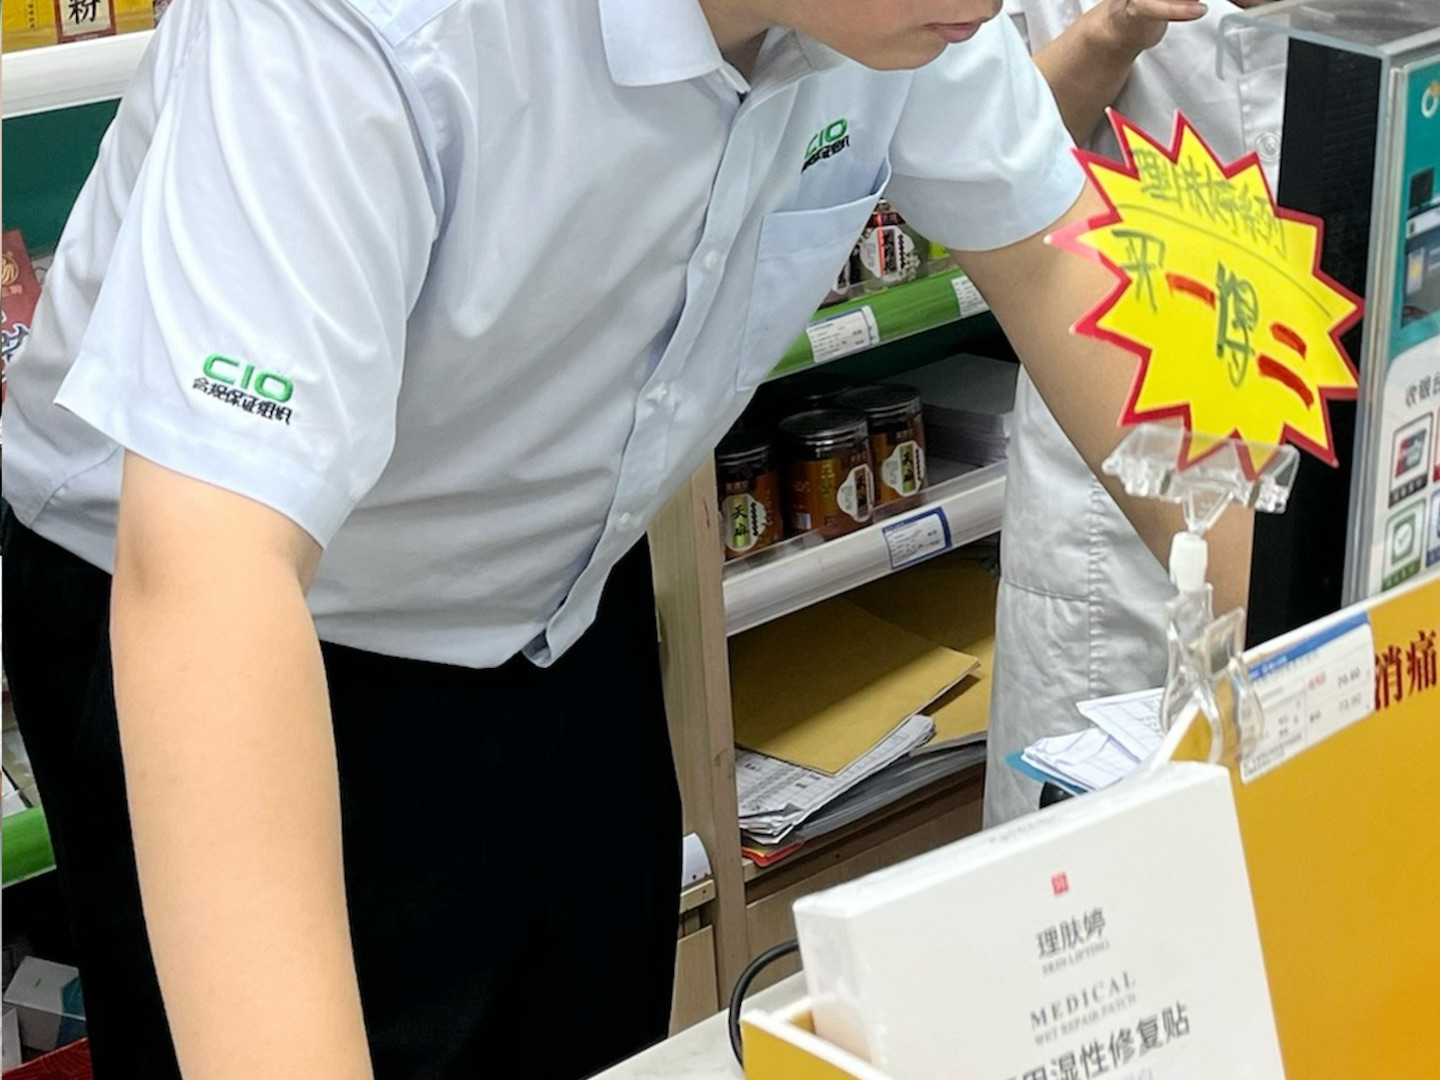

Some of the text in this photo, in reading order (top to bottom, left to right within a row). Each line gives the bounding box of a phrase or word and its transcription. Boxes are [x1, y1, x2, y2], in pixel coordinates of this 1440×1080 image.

[202, 351, 295, 403] CIO
[1036, 907, 1107, 959] 理肤婷
[1030, 971, 1136, 1031] MEDICAL
